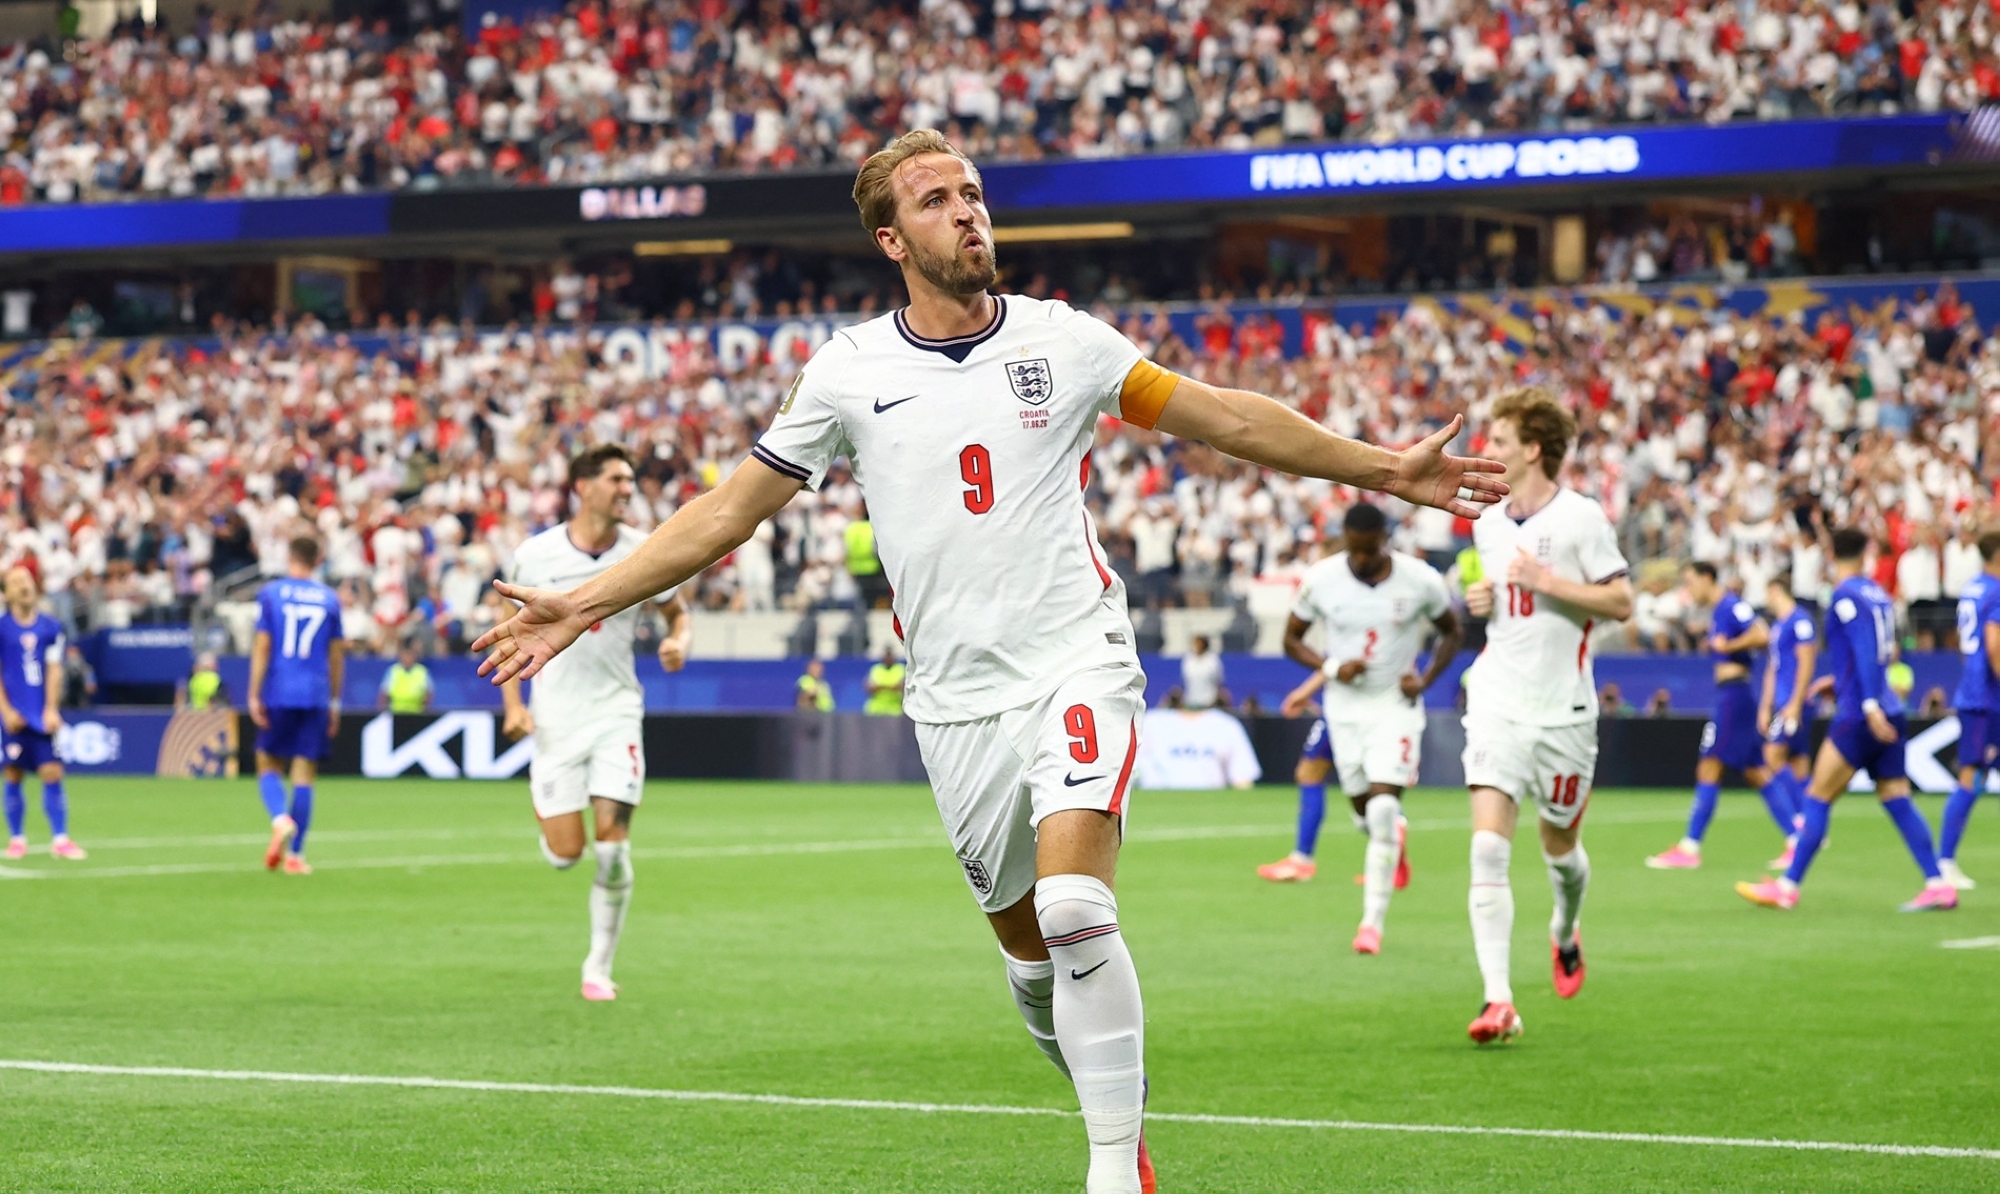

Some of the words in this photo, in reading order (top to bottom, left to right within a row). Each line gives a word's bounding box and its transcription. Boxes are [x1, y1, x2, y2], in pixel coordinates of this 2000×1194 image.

[1250, 153, 1324, 191] FIFA
[1321, 147, 1444, 187] WORLD
[1444, 142, 1516, 181] CUP
[1515, 135, 1640, 177] 2026
[1019, 409, 1051, 420] CROATIA
[1022, 419, 1048, 430] 17.06.26
[959, 444, 995, 515] 9
[281, 602, 328, 659] 17
[1364, 628, 1378, 659] 2
[1063, 703, 1098, 764] 9
[1400, 736, 1412, 764] 2
[1551, 774, 1579, 807] 18
